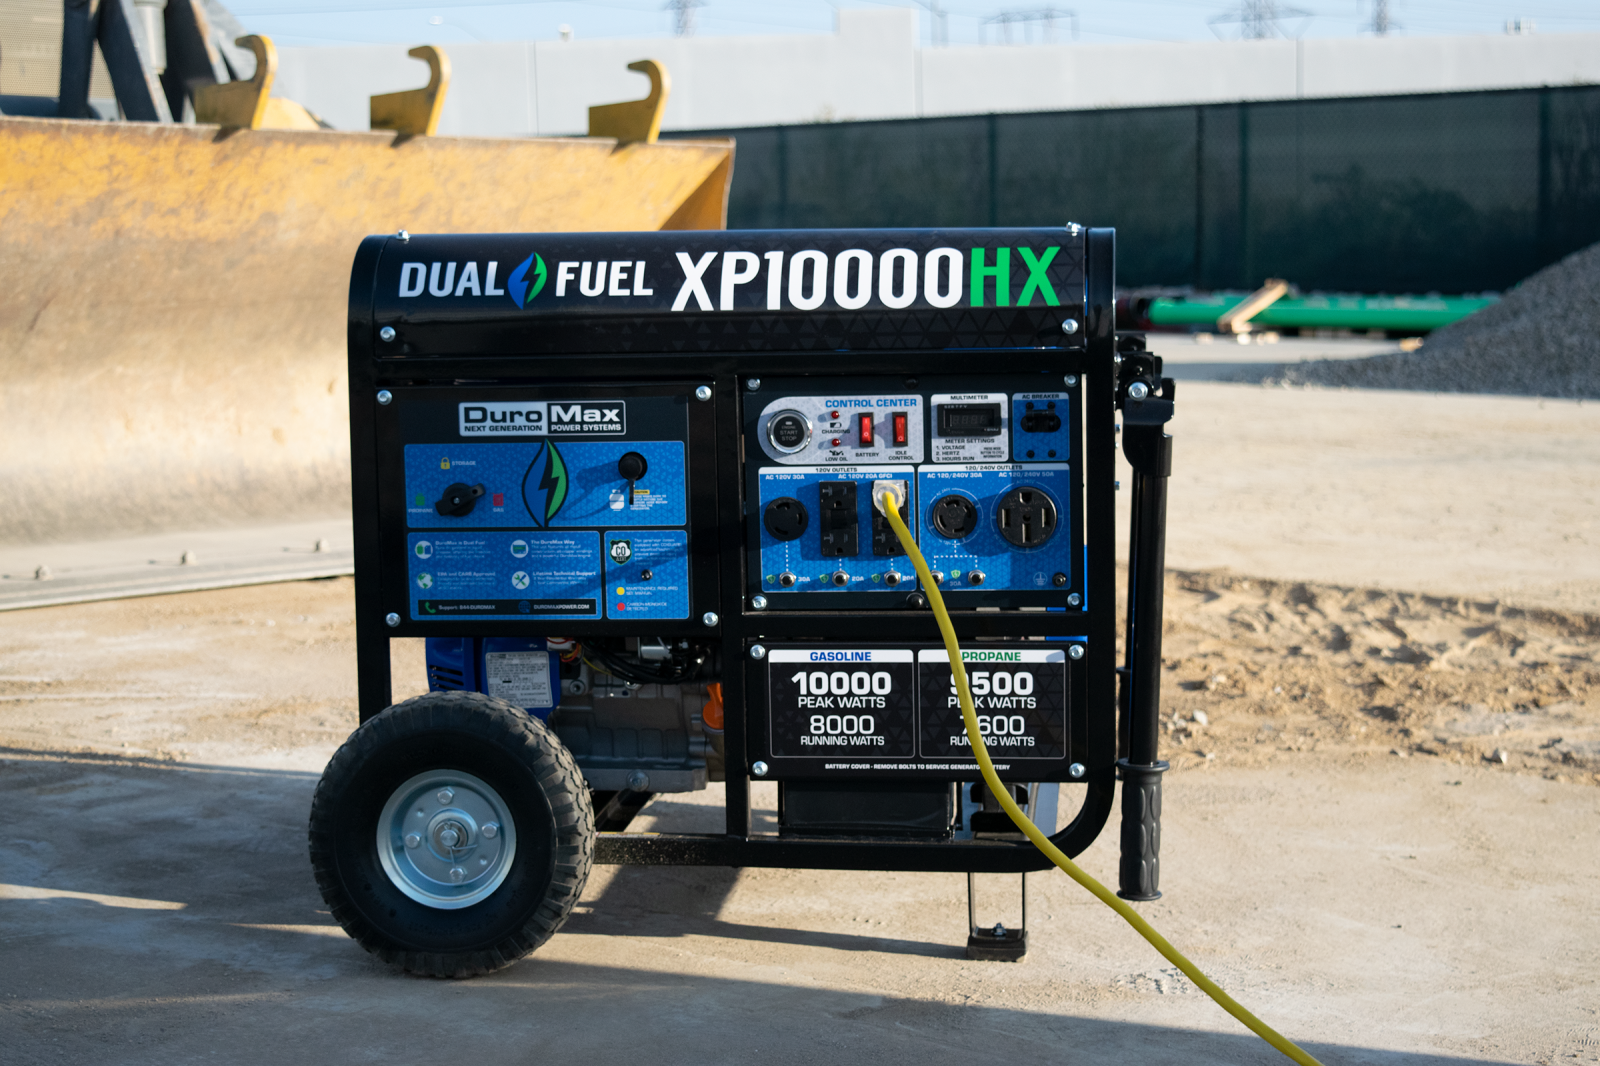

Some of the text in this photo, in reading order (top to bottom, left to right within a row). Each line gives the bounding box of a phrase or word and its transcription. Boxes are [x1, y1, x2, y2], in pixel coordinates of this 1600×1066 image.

[399, 246, 1061, 311] DUAL FUEL XP10000HX
[825, 399, 917, 408] CONTROL CENTER
[615, 546, 626, 556] CO
[810, 652, 872, 661] GASOLINE
[962, 651, 1021, 661] PROPANE
[791, 671, 892, 696] 10000
[798, 697, 886, 708] PEAK WATTS
[948, 697, 1037, 708] PK WATTS
[810, 715, 875, 735] 8000
[800, 736, 885, 746] RUNNING WATTS
[950, 736, 1036, 746] RUNNG WATTS
